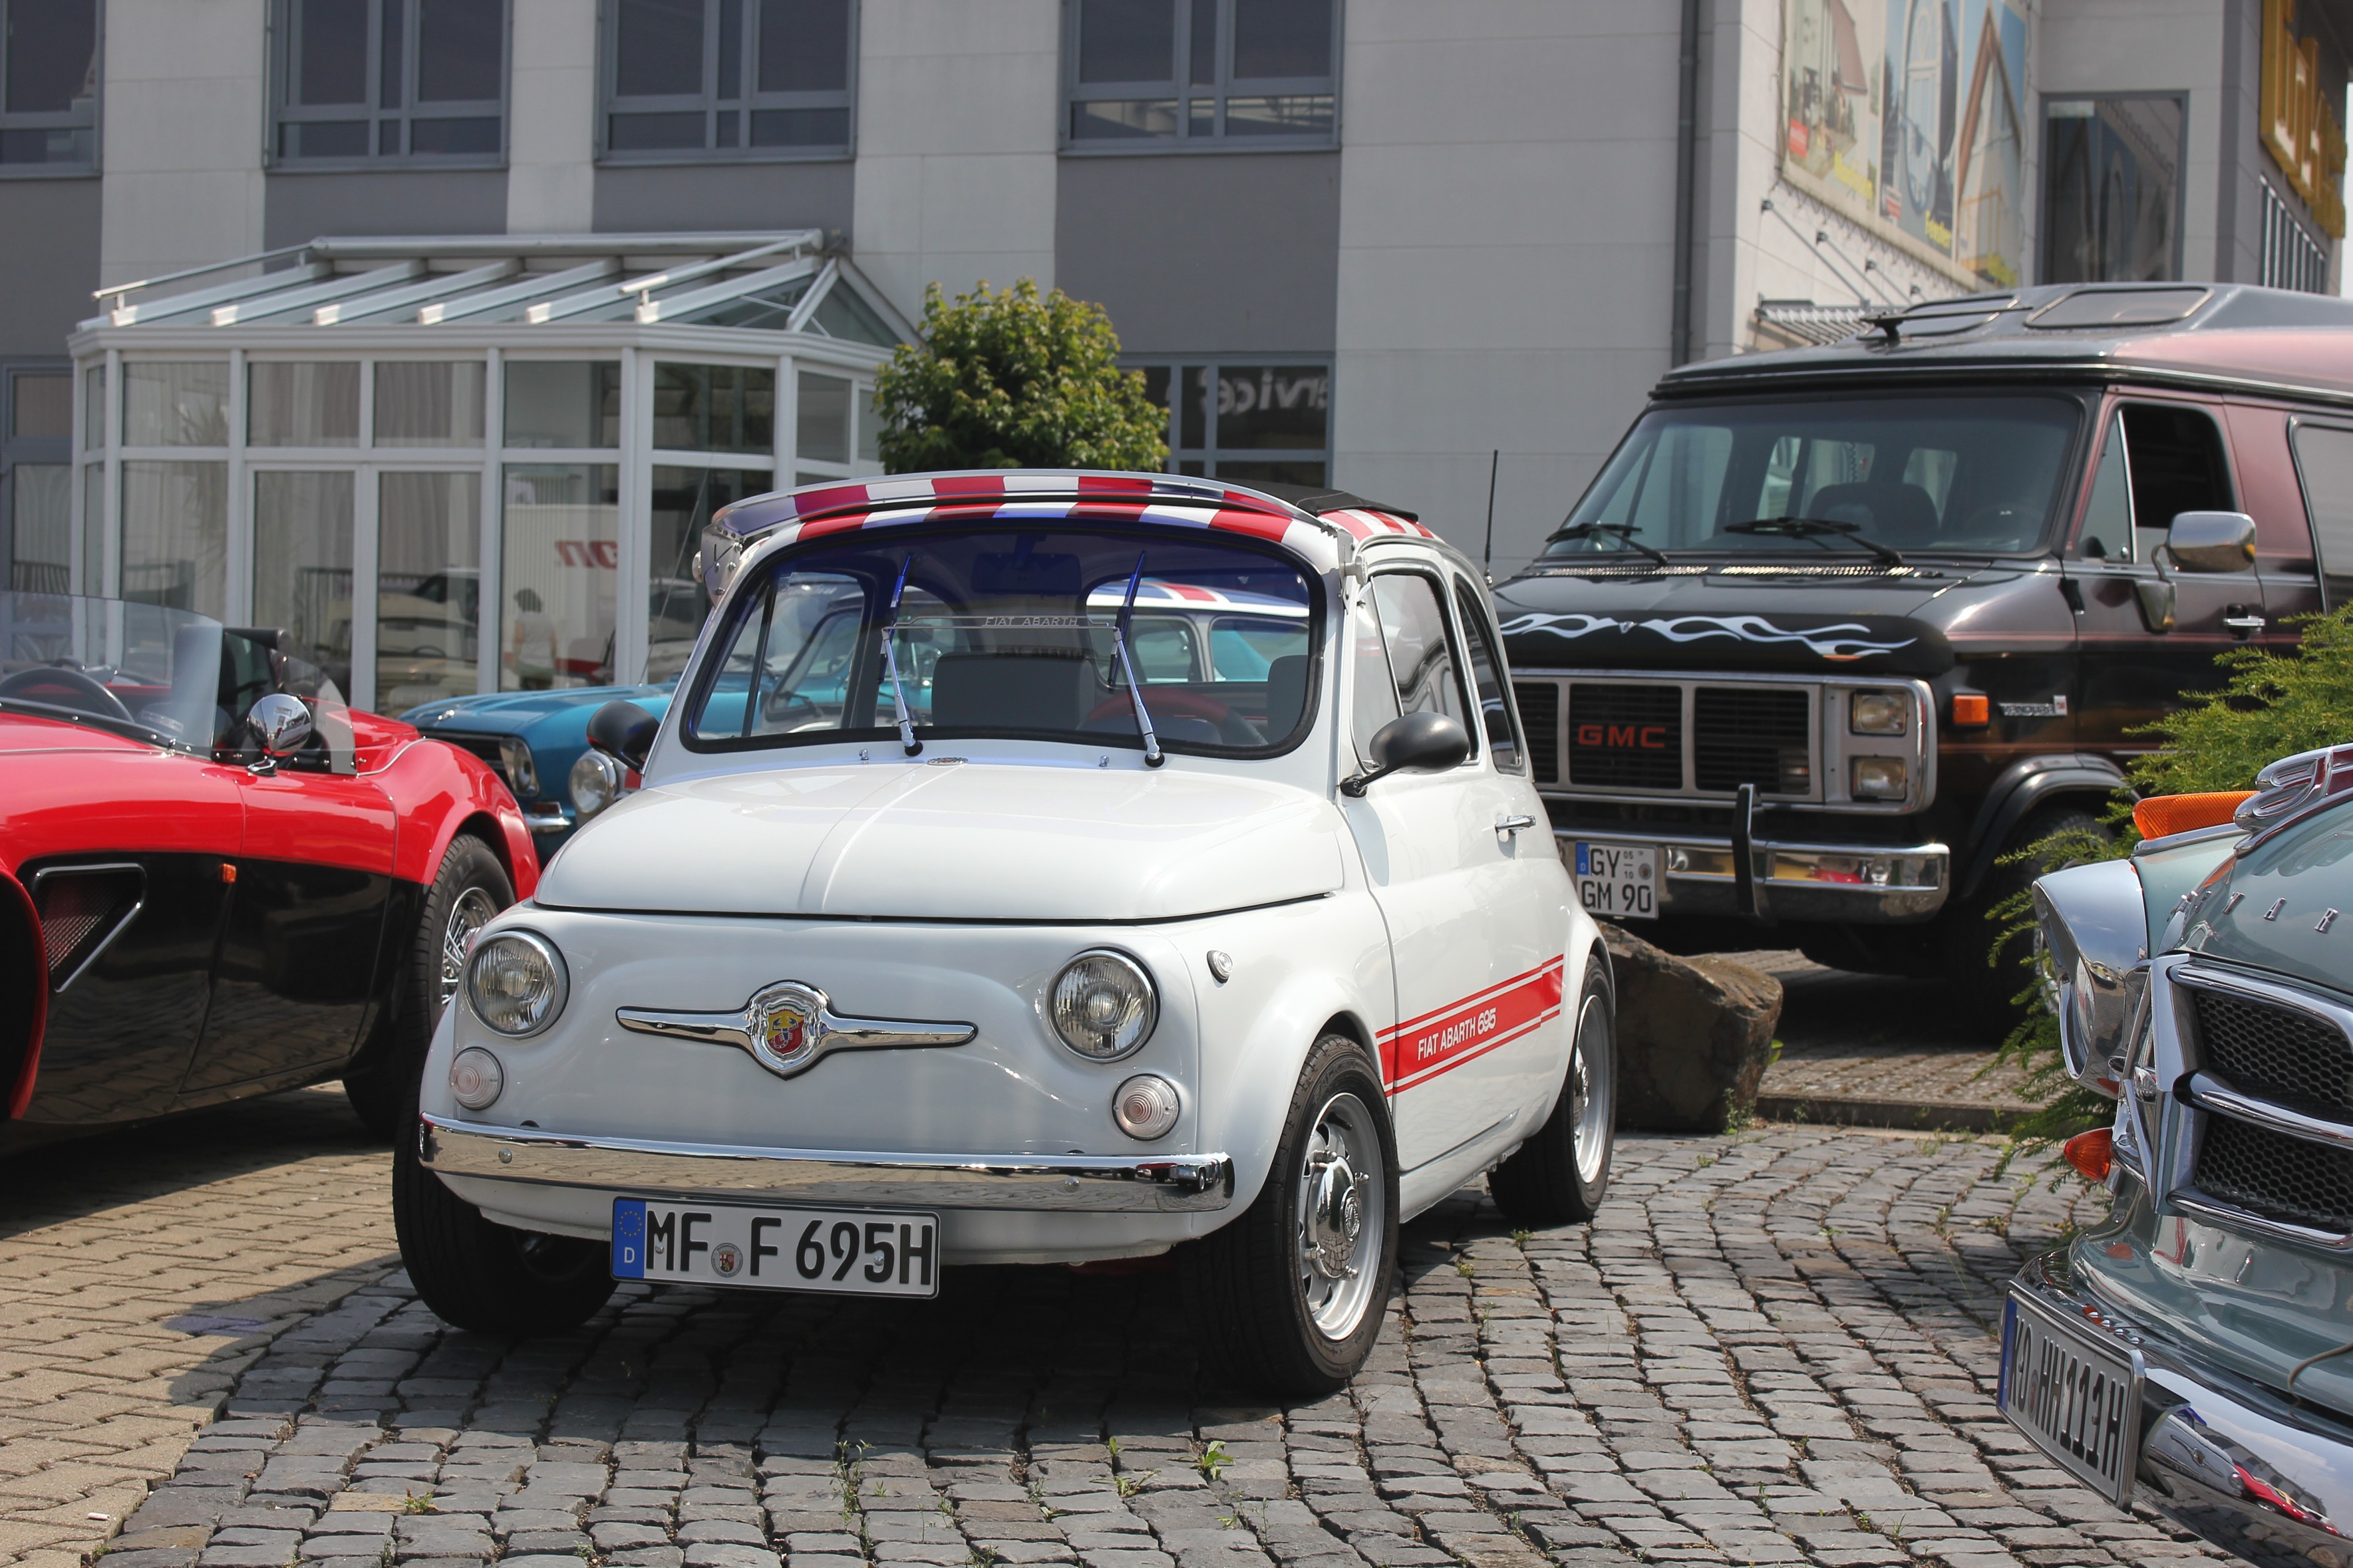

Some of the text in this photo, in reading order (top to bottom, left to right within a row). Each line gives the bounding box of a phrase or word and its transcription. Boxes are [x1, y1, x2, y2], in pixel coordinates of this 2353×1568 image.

[984, 617, 1079, 626] FIAT ABARTH
[1578, 725, 1666, 748] GMC
[1590, 848, 1620, 878] GY
[1582, 880, 1651, 913] GM 90
[1418, 1007, 1497, 1061] FIAT ABARTH 695
[624, 1246, 635, 1264] D
[646, 1210, 712, 1272] MF
[750, 1216, 782, 1276] F
[796, 1220, 933, 1285] 695H
